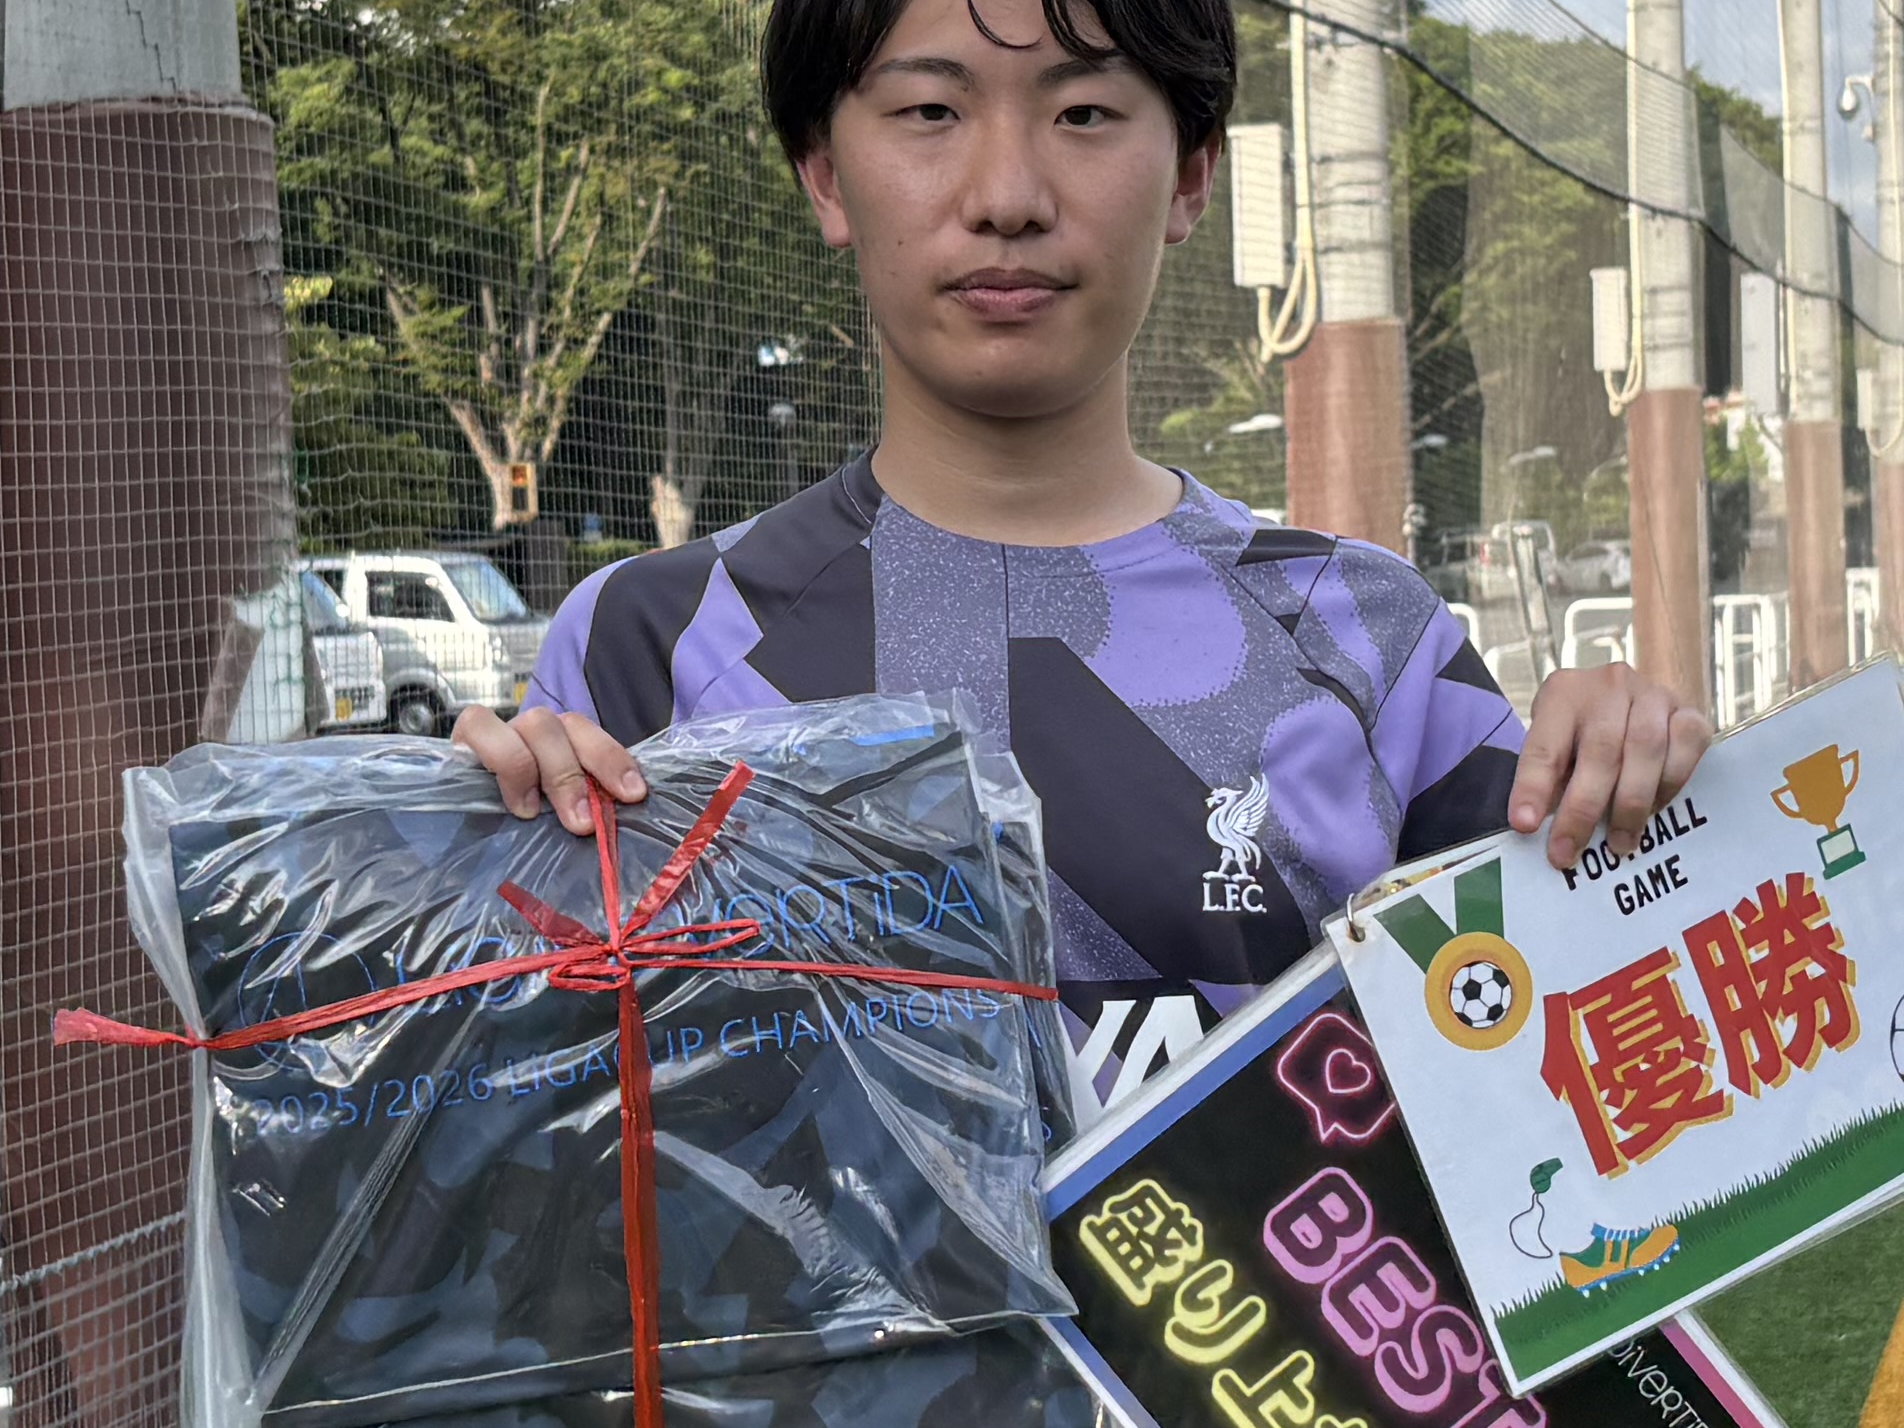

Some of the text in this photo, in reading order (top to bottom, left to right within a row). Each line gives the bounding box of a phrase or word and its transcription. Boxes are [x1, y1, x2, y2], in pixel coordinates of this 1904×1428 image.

[1561, 797, 1708, 892] FOOBALL
[1613, 854, 1689, 916] GAME
[251, 1062, 494, 1137] 2025/2026
[719, 987, 1001, 1058] CHAMPIONS
[1540, 871, 1861, 1180] 優勝
